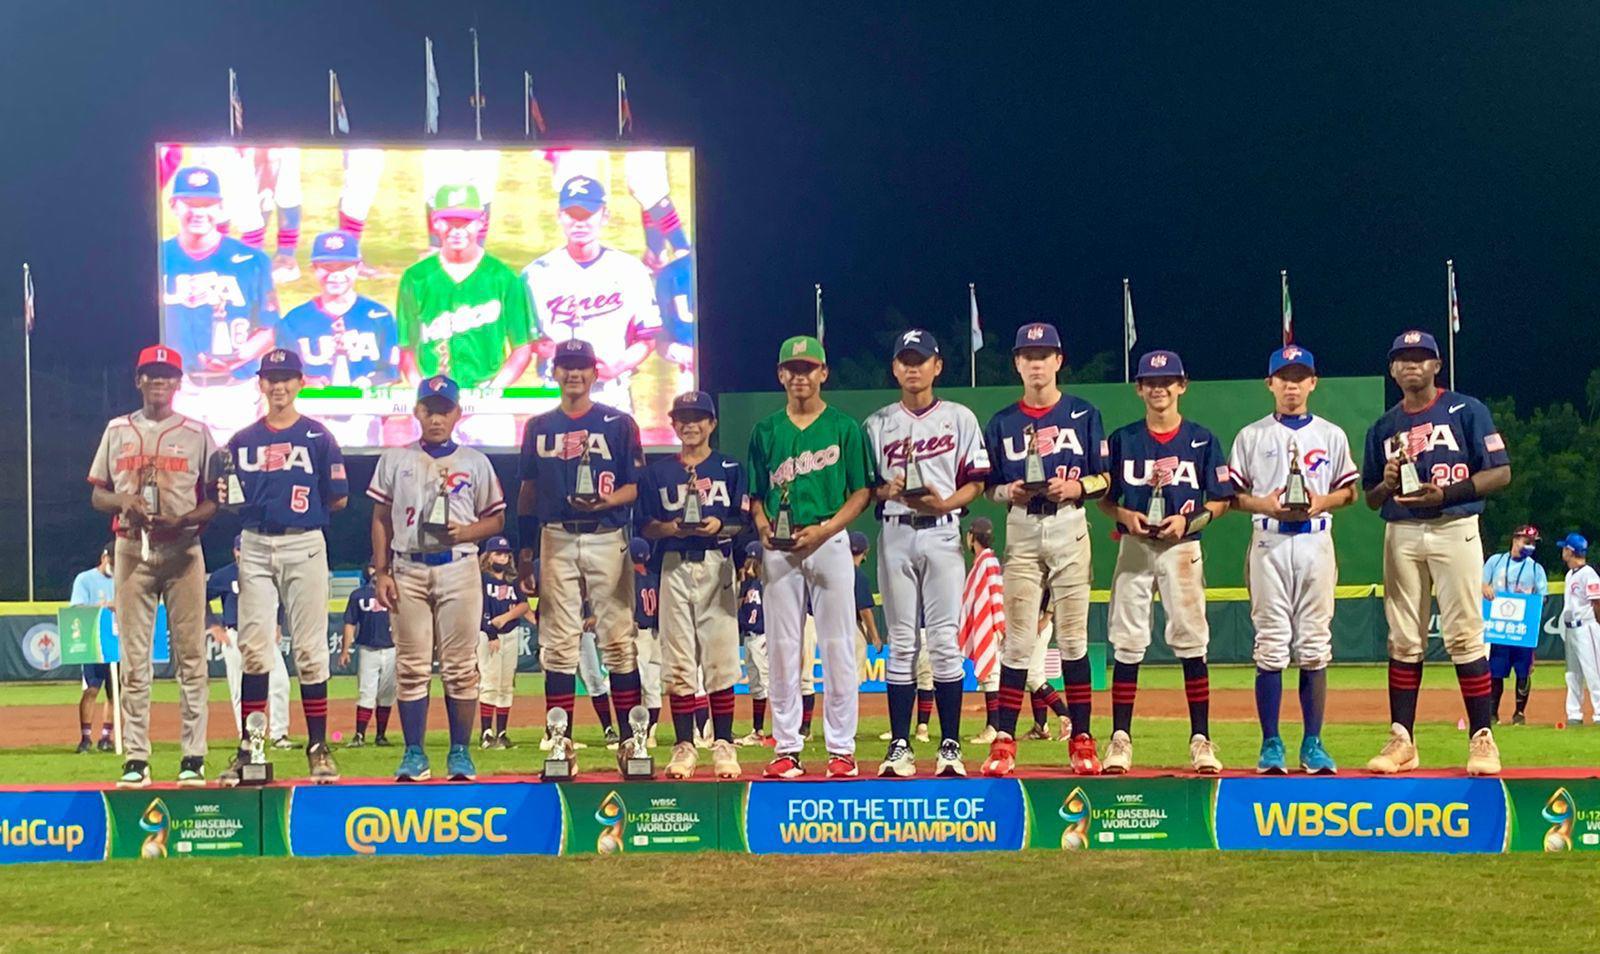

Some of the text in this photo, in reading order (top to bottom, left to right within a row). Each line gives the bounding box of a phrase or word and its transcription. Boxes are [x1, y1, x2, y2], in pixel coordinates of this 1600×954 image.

[536, 429, 613, 461] USA
[1002, 425, 1084, 461] USA
[1383, 422, 1460, 461] USA
[238, 442, 314, 475] USA
[1123, 455, 1200, 490] USA
[1431, 463, 1470, 487] 29
[291, 485, 311, 514] 5
[406, 506, 416, 528] 2
[195, 805, 220, 813] WBSC
[651, 798, 677, 806] WBSC
[788, 798, 985, 821] FOR THE TITLE OF
[1116, 794, 1143, 802] WBSC
[171, 819, 243, 830] U-12 BASEBALL
[627, 813, 700, 823] U-12 BASEBALL
[1092, 809, 1168, 820] U-12 BASEBALL
[1101, 819, 1160, 829] WORLD CUP
[1253, 801, 1470, 838] WBSC.ORG
[0, 819, 84, 852] ldCup
[180, 829, 235, 839] WORLD CUP
[345, 806, 508, 854] @WBSC
[636, 823, 693, 833] WORLD CUP
[779, 820, 996, 844] WORLD CHAMPION
